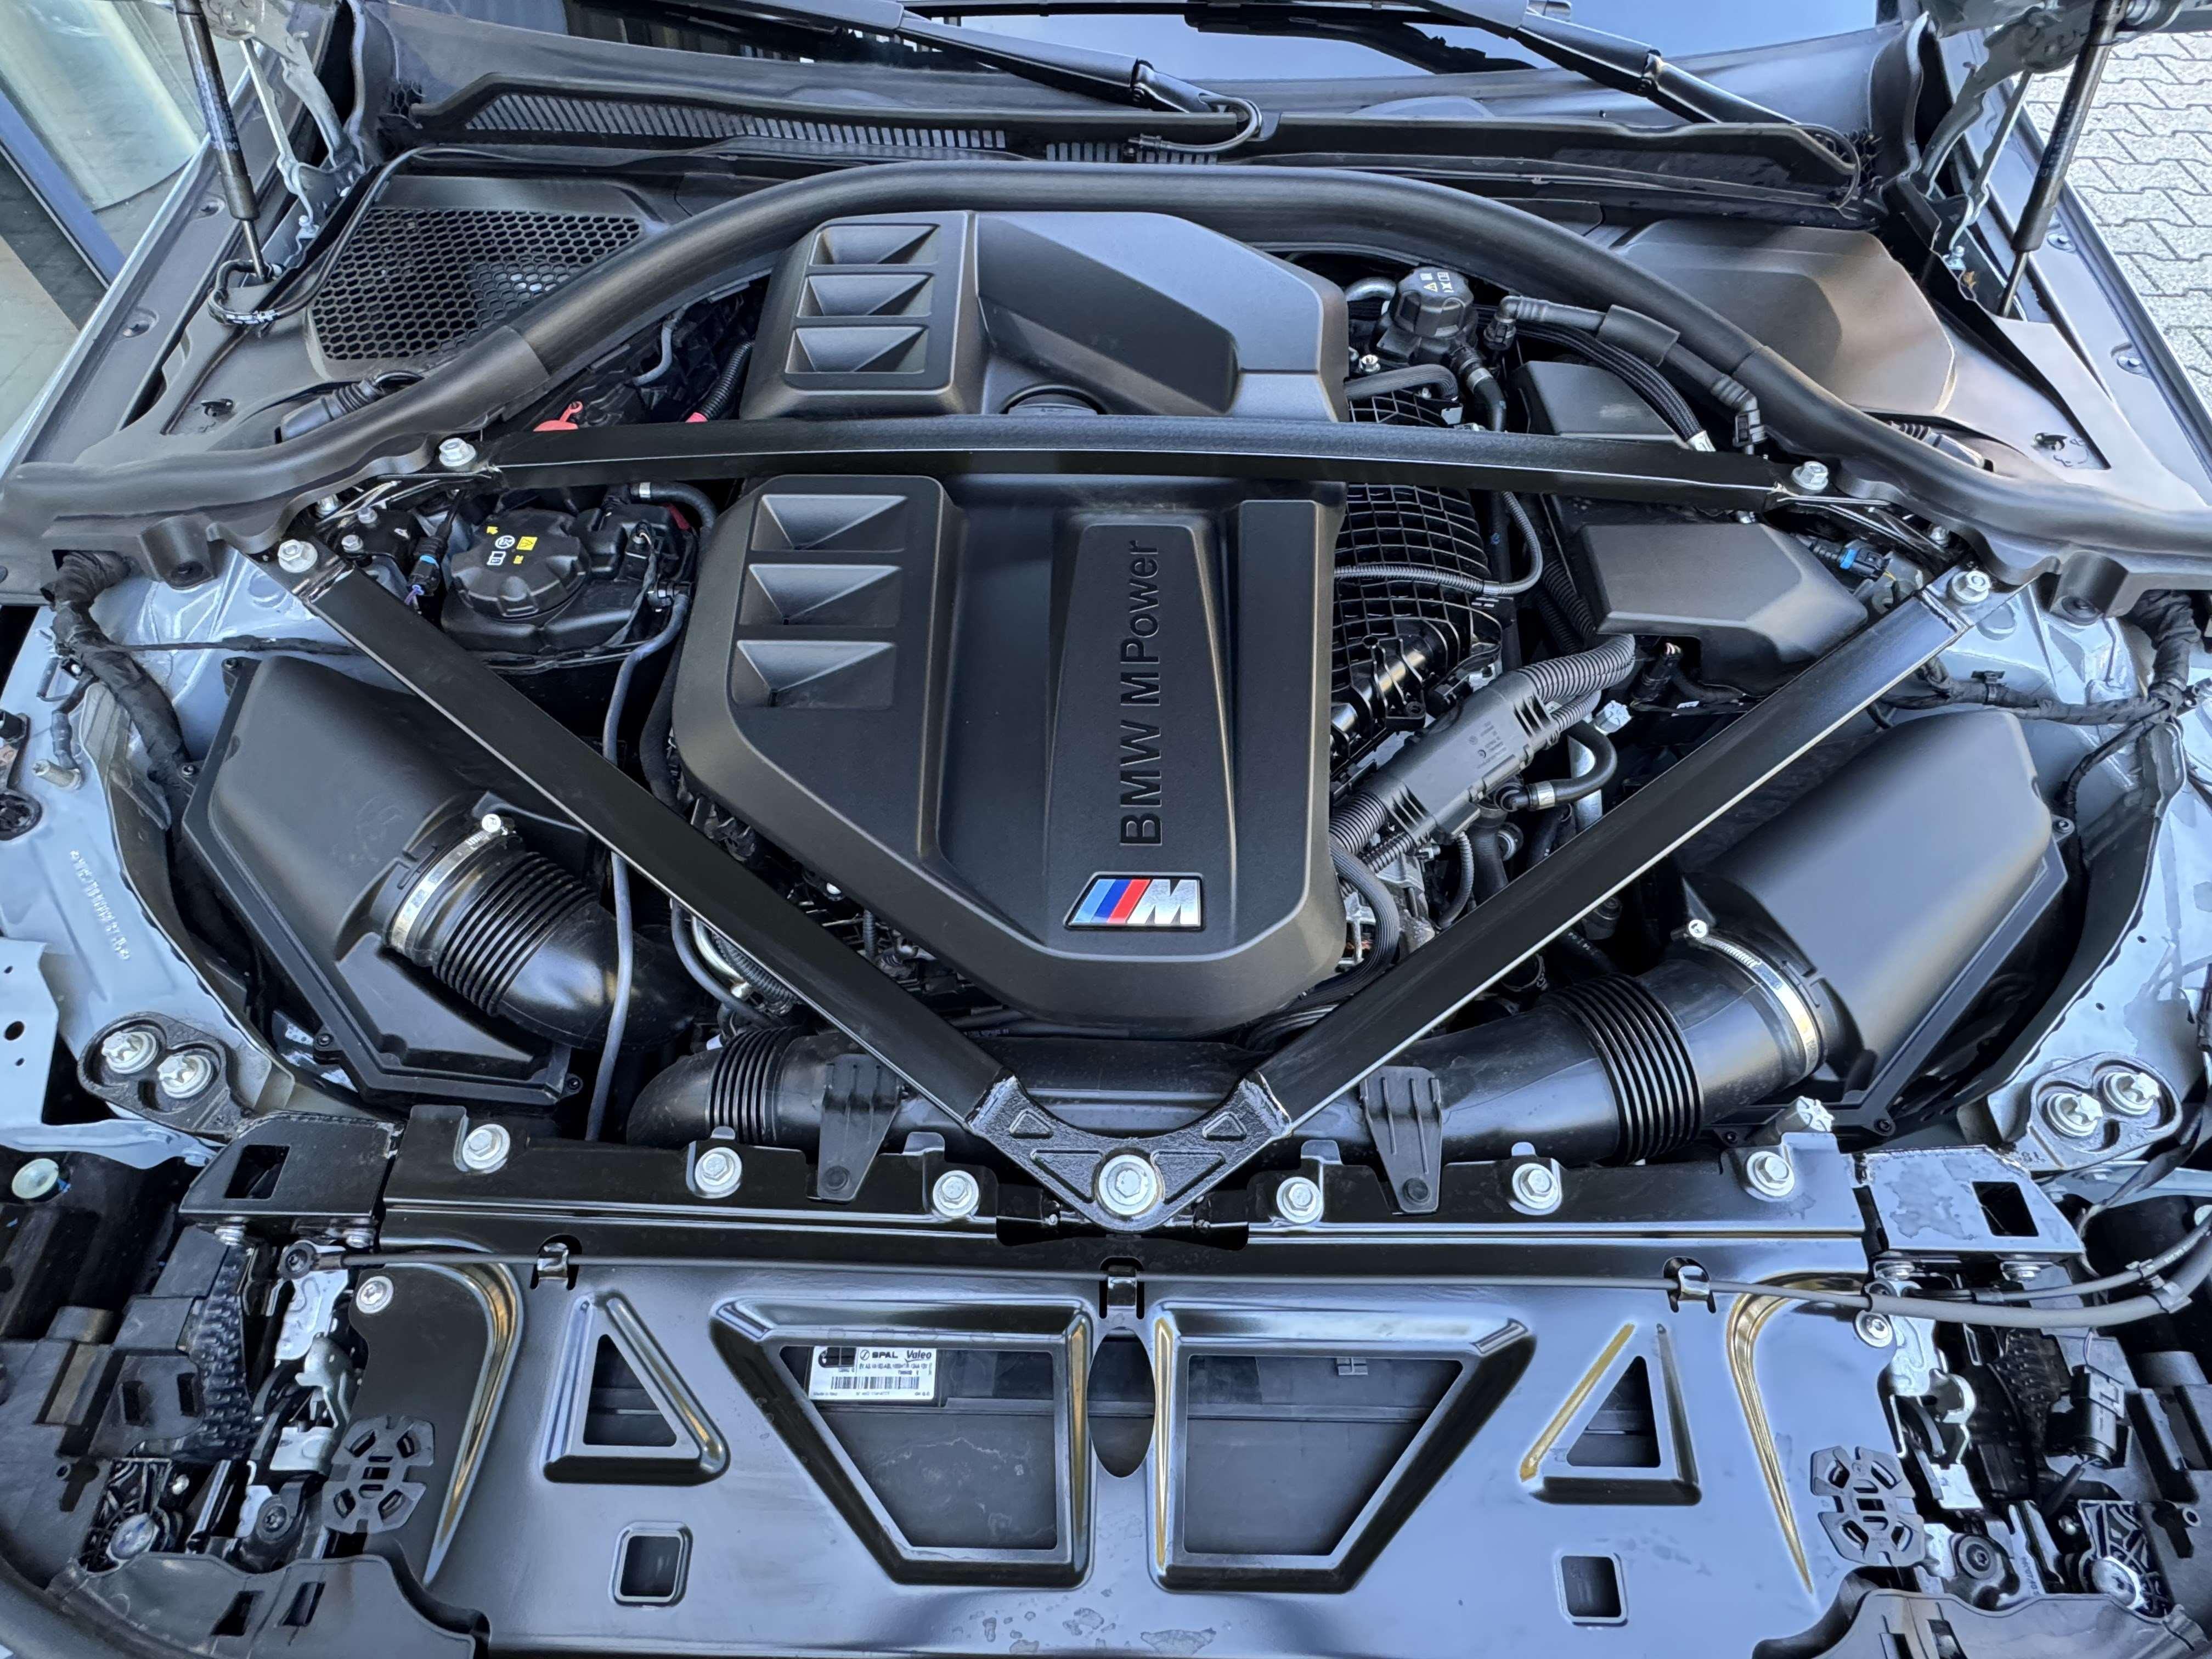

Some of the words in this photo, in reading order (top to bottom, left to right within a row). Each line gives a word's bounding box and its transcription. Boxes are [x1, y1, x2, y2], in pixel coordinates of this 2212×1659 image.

[1120, 719, 1162, 846] BMW
[1127, 879, 1199, 926] M
[906, 1350, 932, 1359] Valeo
